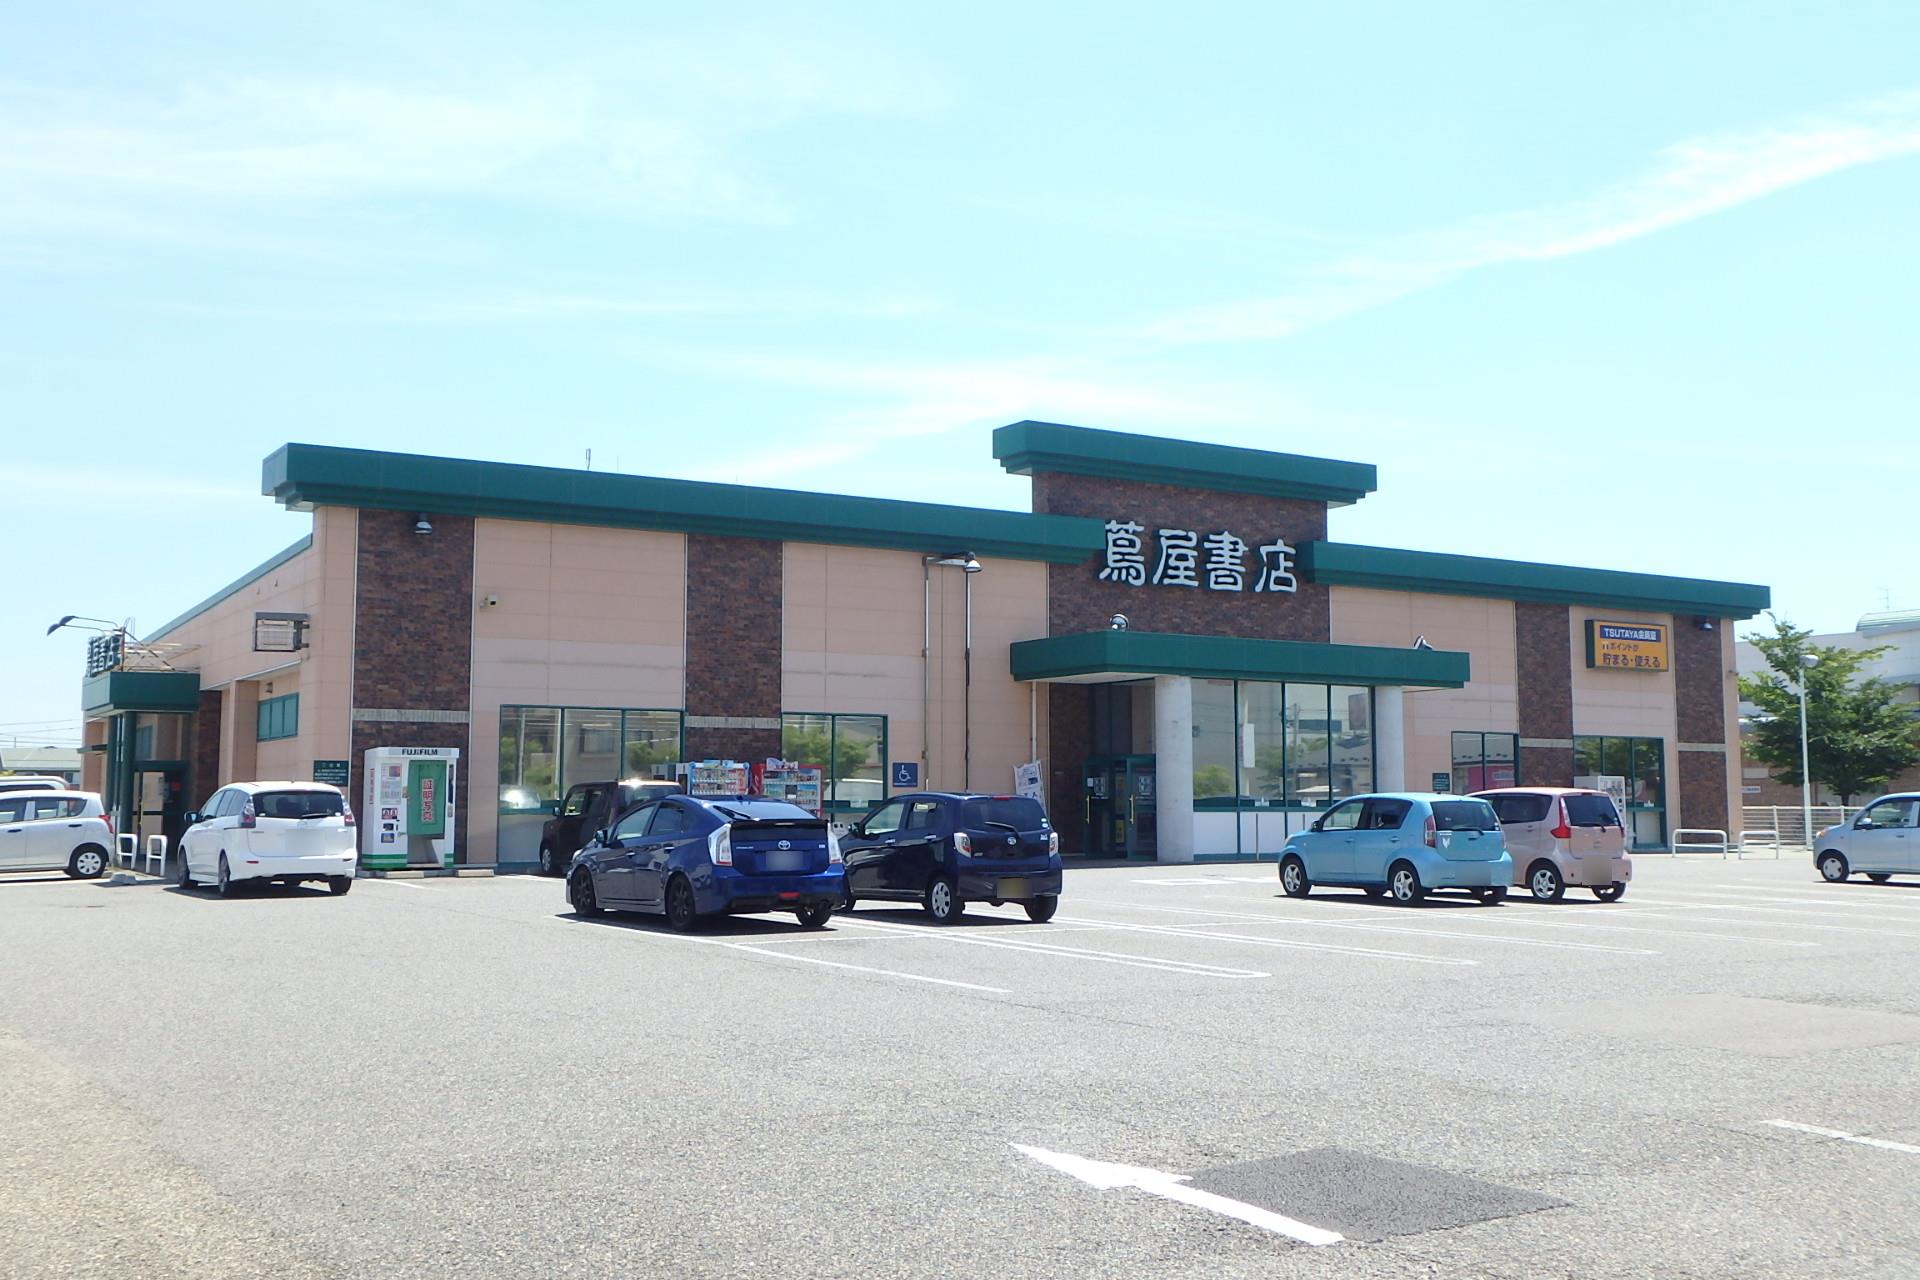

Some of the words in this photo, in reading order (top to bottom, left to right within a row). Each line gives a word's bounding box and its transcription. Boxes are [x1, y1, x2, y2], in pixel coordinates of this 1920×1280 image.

[1099, 519, 1297, 593] 蔦屋書店
[402, 748, 438, 756] FUJIFILM
